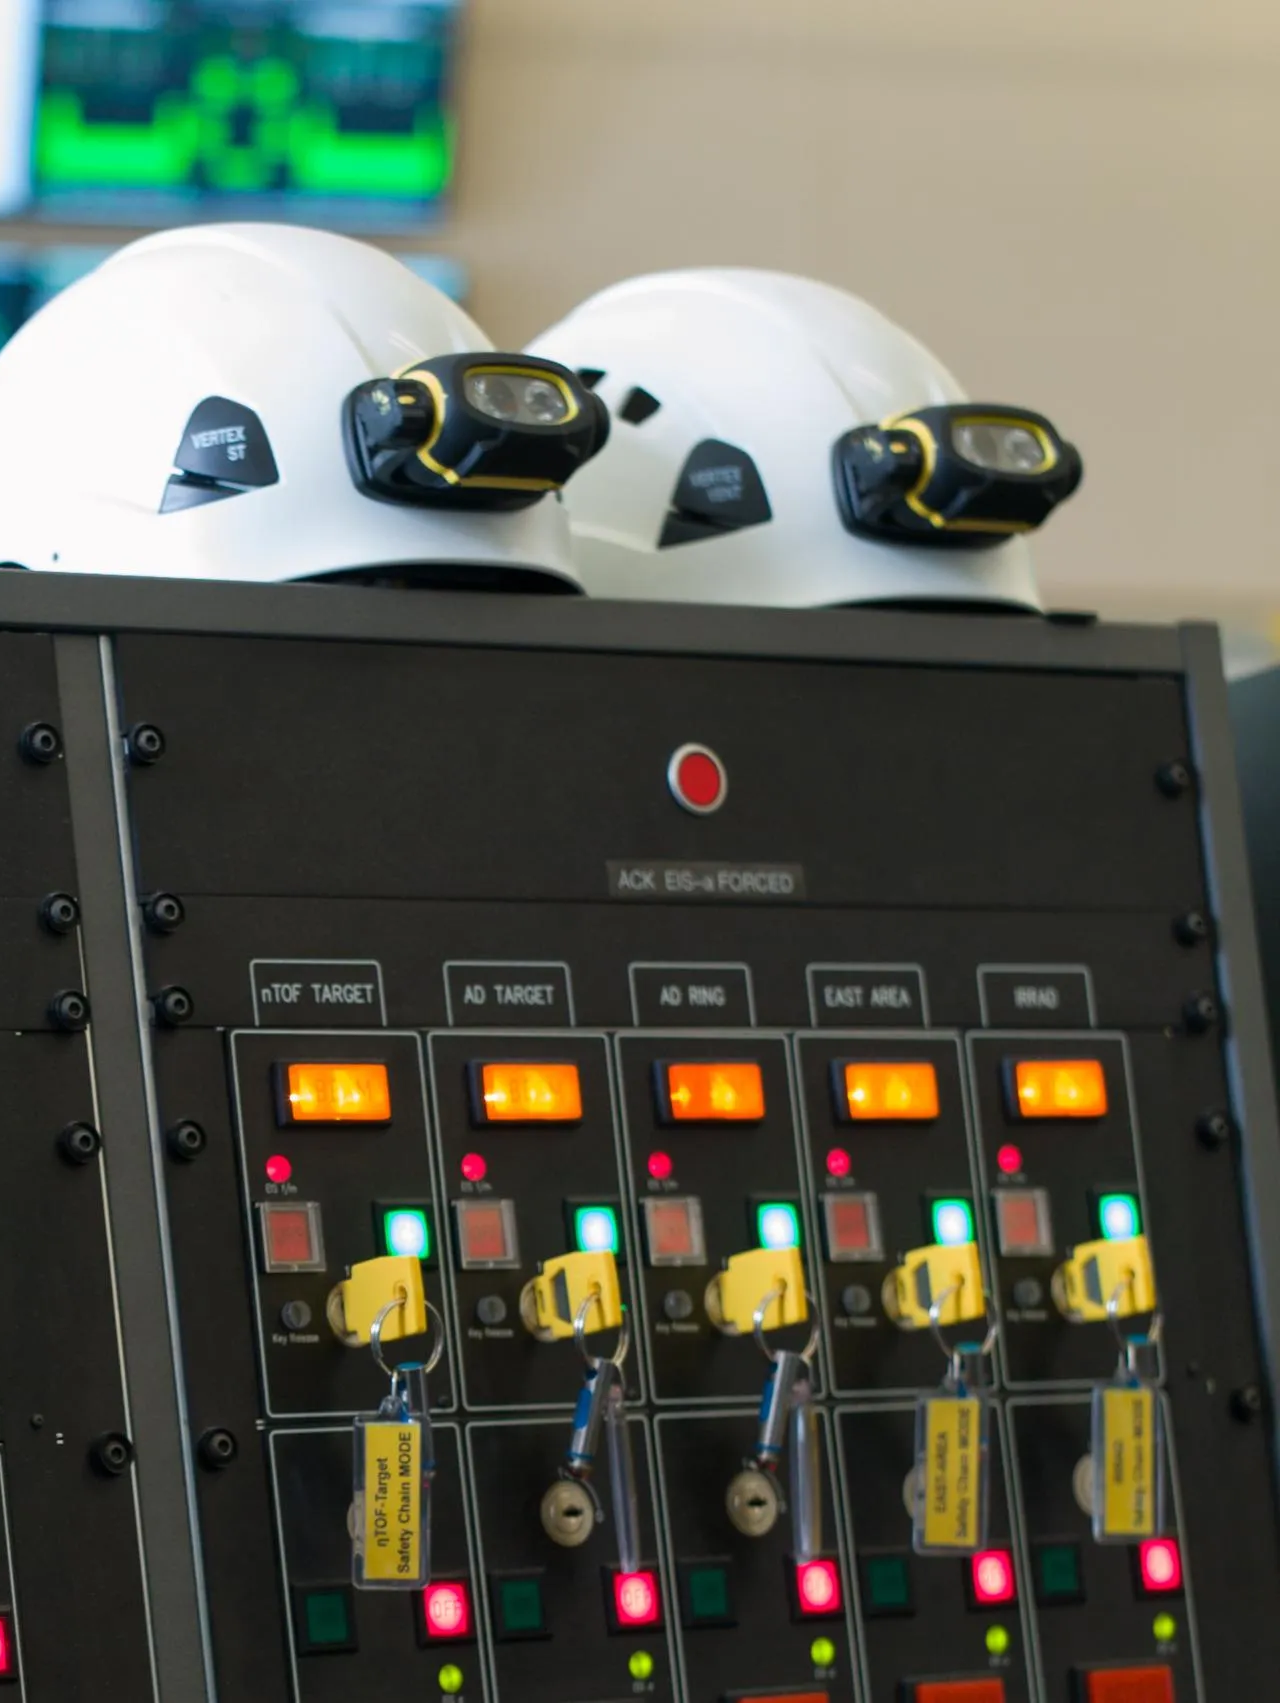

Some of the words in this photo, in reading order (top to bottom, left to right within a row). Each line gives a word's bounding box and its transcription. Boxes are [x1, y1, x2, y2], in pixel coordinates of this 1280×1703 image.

[191, 426, 245, 448] VERTEX
[227, 445, 246, 461] ST
[618, 870, 656, 890] ACK
[718, 872, 794, 894] FORCED
[261, 983, 302, 1004] nTOF
[311, 983, 375, 1004] TARGET
[463, 984, 486, 1004] AD
[493, 985, 554, 1004] TARGET
[660, 985, 683, 1005] AD
[688, 986, 726, 1006] RING
[824, 986, 864, 1007] EAST
[870, 987, 912, 1007] AREA
[398, 1432, 412, 1477] MODE
[397, 1481, 412, 1523] Chain
[397, 1527, 414, 1574] Safety
[431, 1600, 461, 1618] OFF
